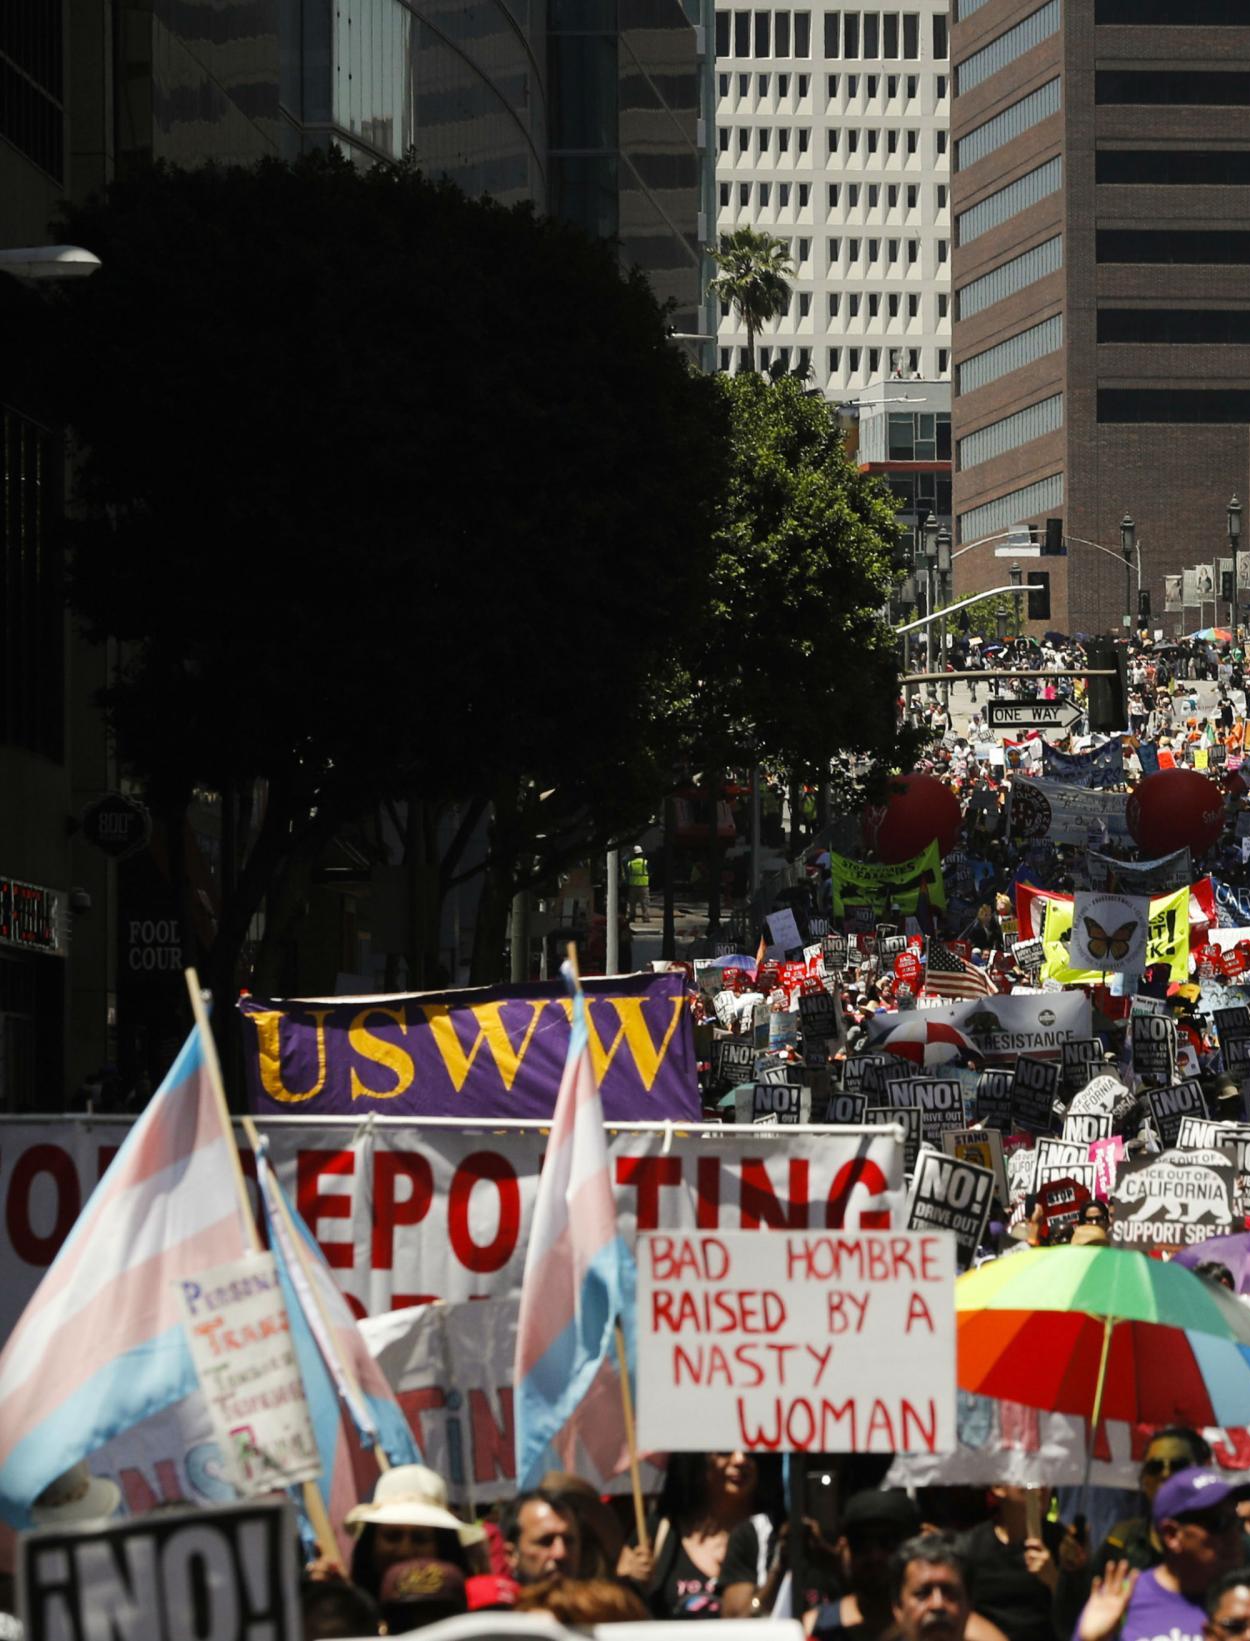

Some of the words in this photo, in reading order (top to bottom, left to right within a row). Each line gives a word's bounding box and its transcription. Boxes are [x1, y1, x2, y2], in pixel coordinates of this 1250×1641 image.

[995, 706, 1025, 722] ONE
[1031, 706, 1061, 722] WAY
[244, 996, 684, 1103] USWW
[984, 1030, 1075, 1051] RESISTANCE
[724, 1045, 754, 1065] ¡NO!
[756, 1087, 798, 1112] NO!
[915, 1082, 961, 1109] NO!
[1152, 1082, 1201, 1117] ¡NO!
[954, 1132, 989, 1146] STAND
[1064, 1115, 1108, 1143] NO!
[919, 1156, 990, 1214] NO!
[1146, 1170, 1165, 1181] ICE
[1167, 1170, 1191, 1181] OUT
[1194, 1170, 1209, 1181] OF
[1049, 1189, 1074, 1205] STOP
[1126, 1180, 1224, 1201] CALIFORNIA
[297, 1149, 893, 1269] EPOTING
[915, 1202, 951, 1226] DRIVE
[952, 1214, 980, 1233] OUT
[1112, 1220, 1185, 1244] SUPPORT
[650, 1237, 731, 1281] BAD
[786, 1237, 944, 1282] HOMBRE
[652, 1290, 787, 1333] RAISED
[828, 1291, 870, 1334] BY
[905, 1291, 936, 1334] A
[673, 1344, 832, 1387] NASTY
[737, 1396, 938, 1453] WOMAN
[36, 1520, 270, 1641] ¡NO!
